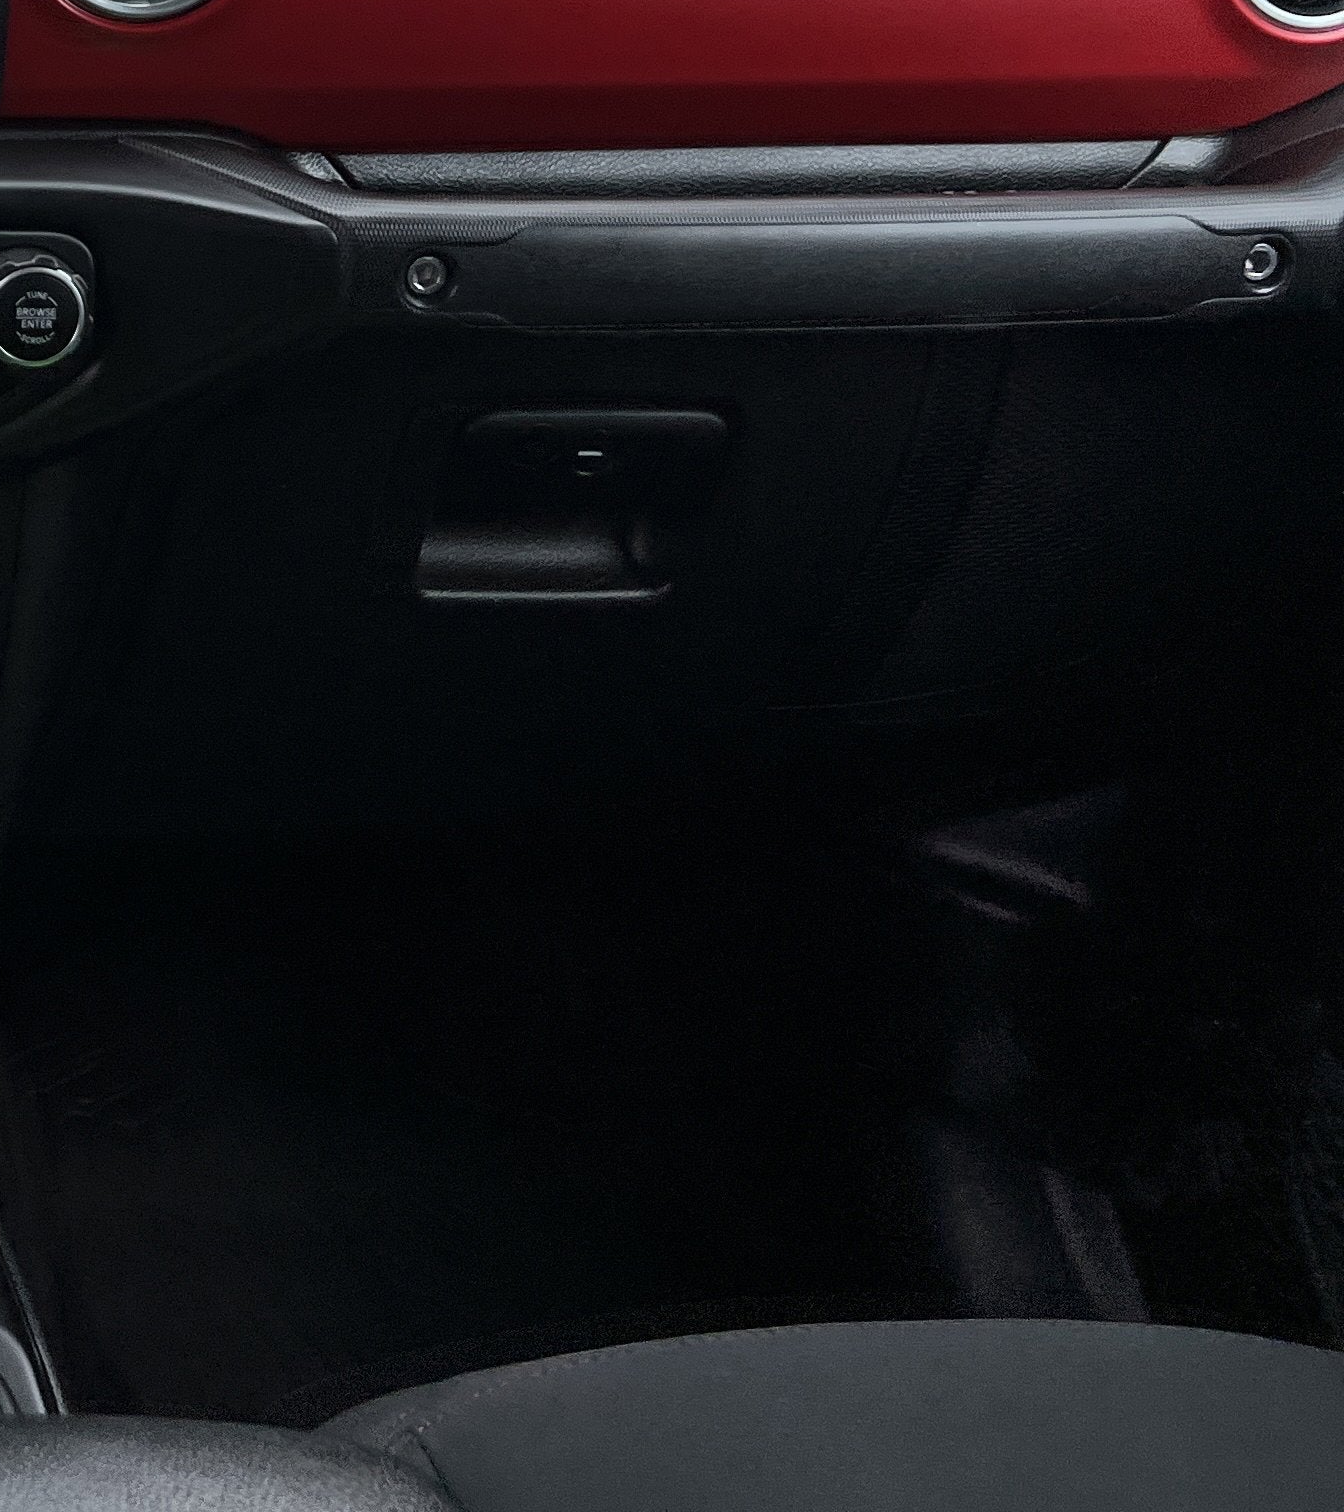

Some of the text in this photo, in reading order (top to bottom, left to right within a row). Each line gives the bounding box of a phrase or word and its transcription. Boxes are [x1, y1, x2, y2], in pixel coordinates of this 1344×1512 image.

[26, 291, 48, 300] TUNE
[16, 308, 56, 317] BROWSE
[21, 319, 53, 329] ENTER
[19, 334, 51, 345] SCROLL
